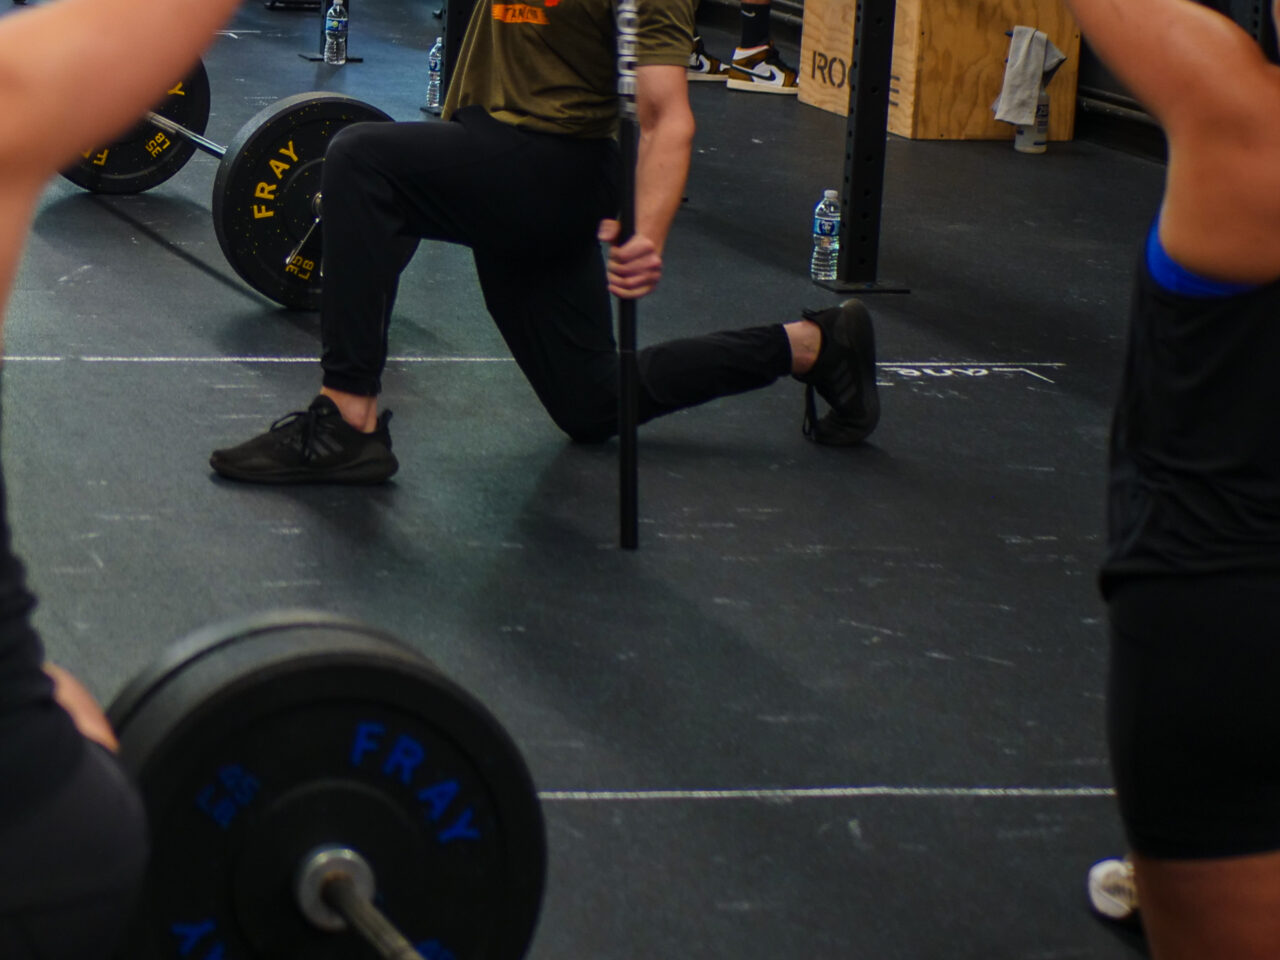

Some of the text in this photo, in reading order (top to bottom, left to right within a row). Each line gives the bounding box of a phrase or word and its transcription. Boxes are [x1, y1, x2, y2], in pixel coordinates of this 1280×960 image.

[811, 50, 901, 108] ROE
[252, 140, 300, 220] FRAY
[349, 720, 481, 845] FRAY
